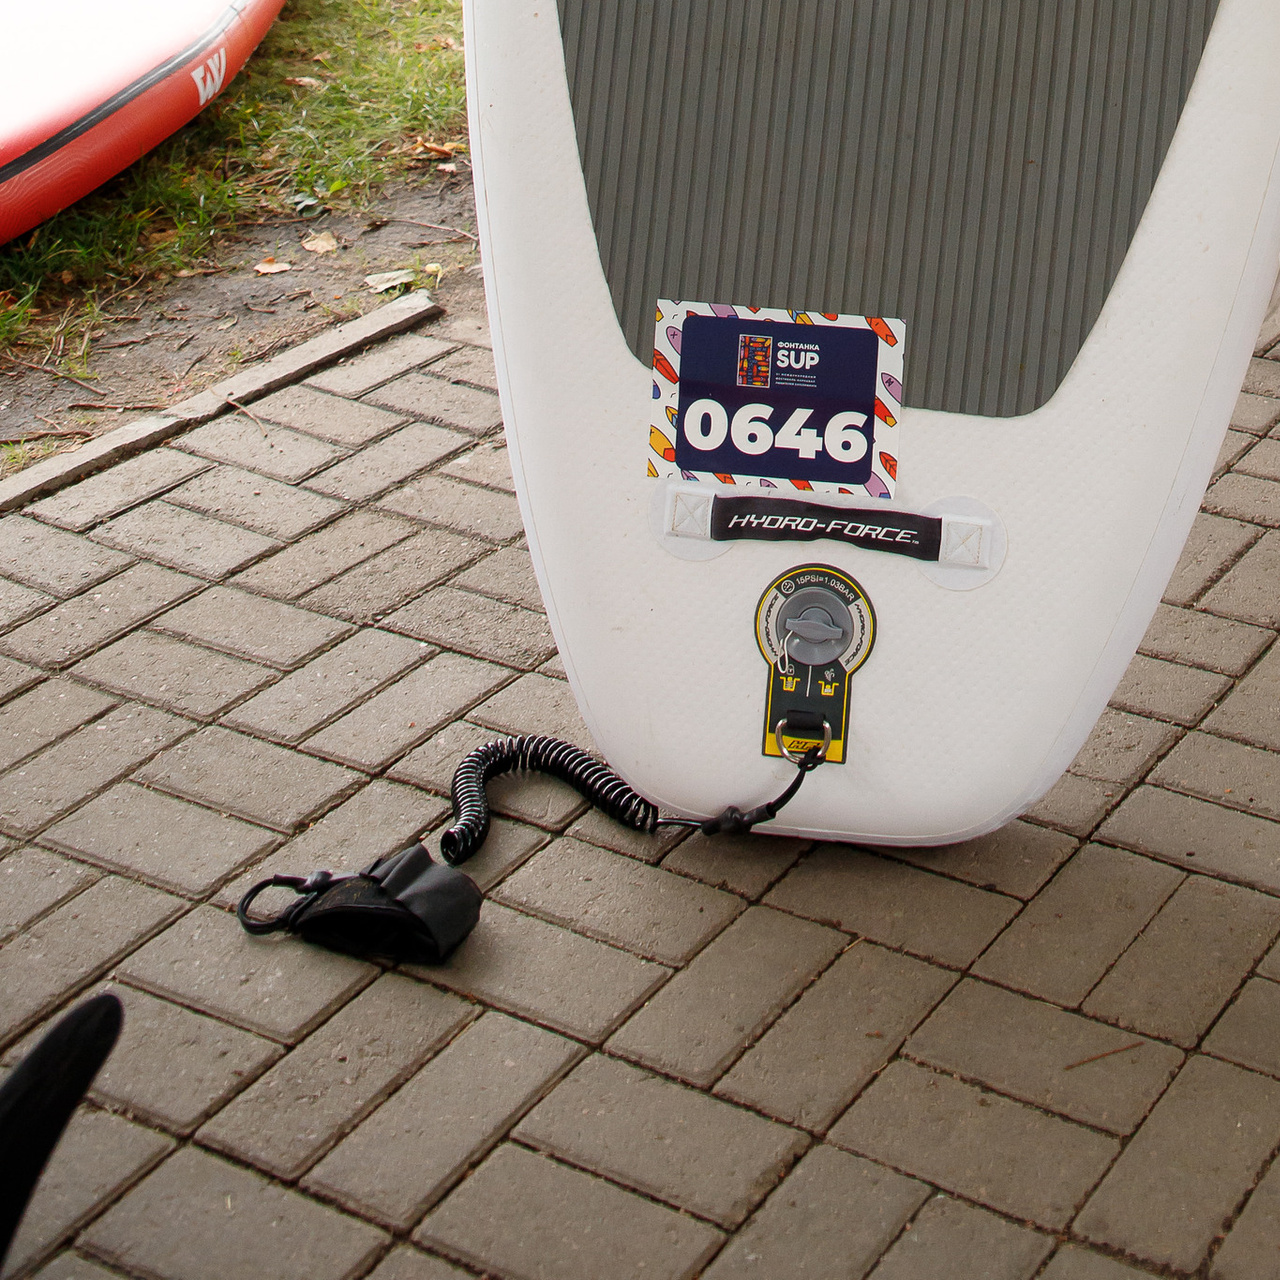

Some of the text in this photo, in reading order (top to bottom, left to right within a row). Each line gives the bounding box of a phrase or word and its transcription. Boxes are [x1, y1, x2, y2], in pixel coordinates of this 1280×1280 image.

[777, 341, 820, 351] ФОНТАНКА
[776, 349, 820, 370] SUP
[683, 398, 868, 463] 0646
[728, 514, 918, 543] HYDRO-FORCE
